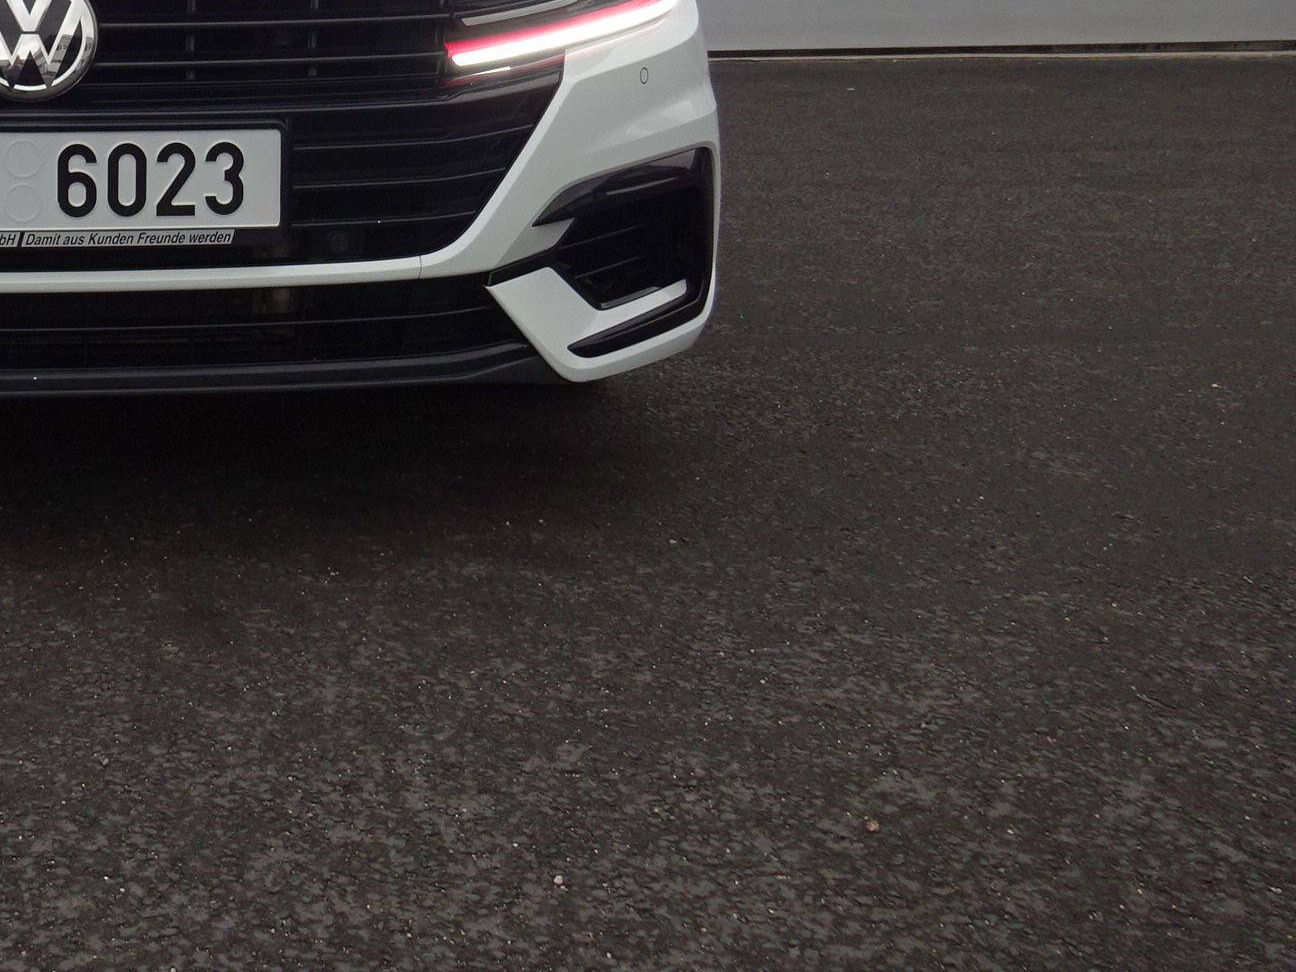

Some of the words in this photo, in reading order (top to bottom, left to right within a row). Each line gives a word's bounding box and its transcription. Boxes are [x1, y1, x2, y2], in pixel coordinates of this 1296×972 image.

[57, 141, 245, 217] 6023
[25, 232, 61, 246] Damit
[63, 234, 84, 245] aus
[88, 232, 134, 245] Kunden
[137, 231, 186, 244] Freunde
[189, 230, 232, 244] werden
